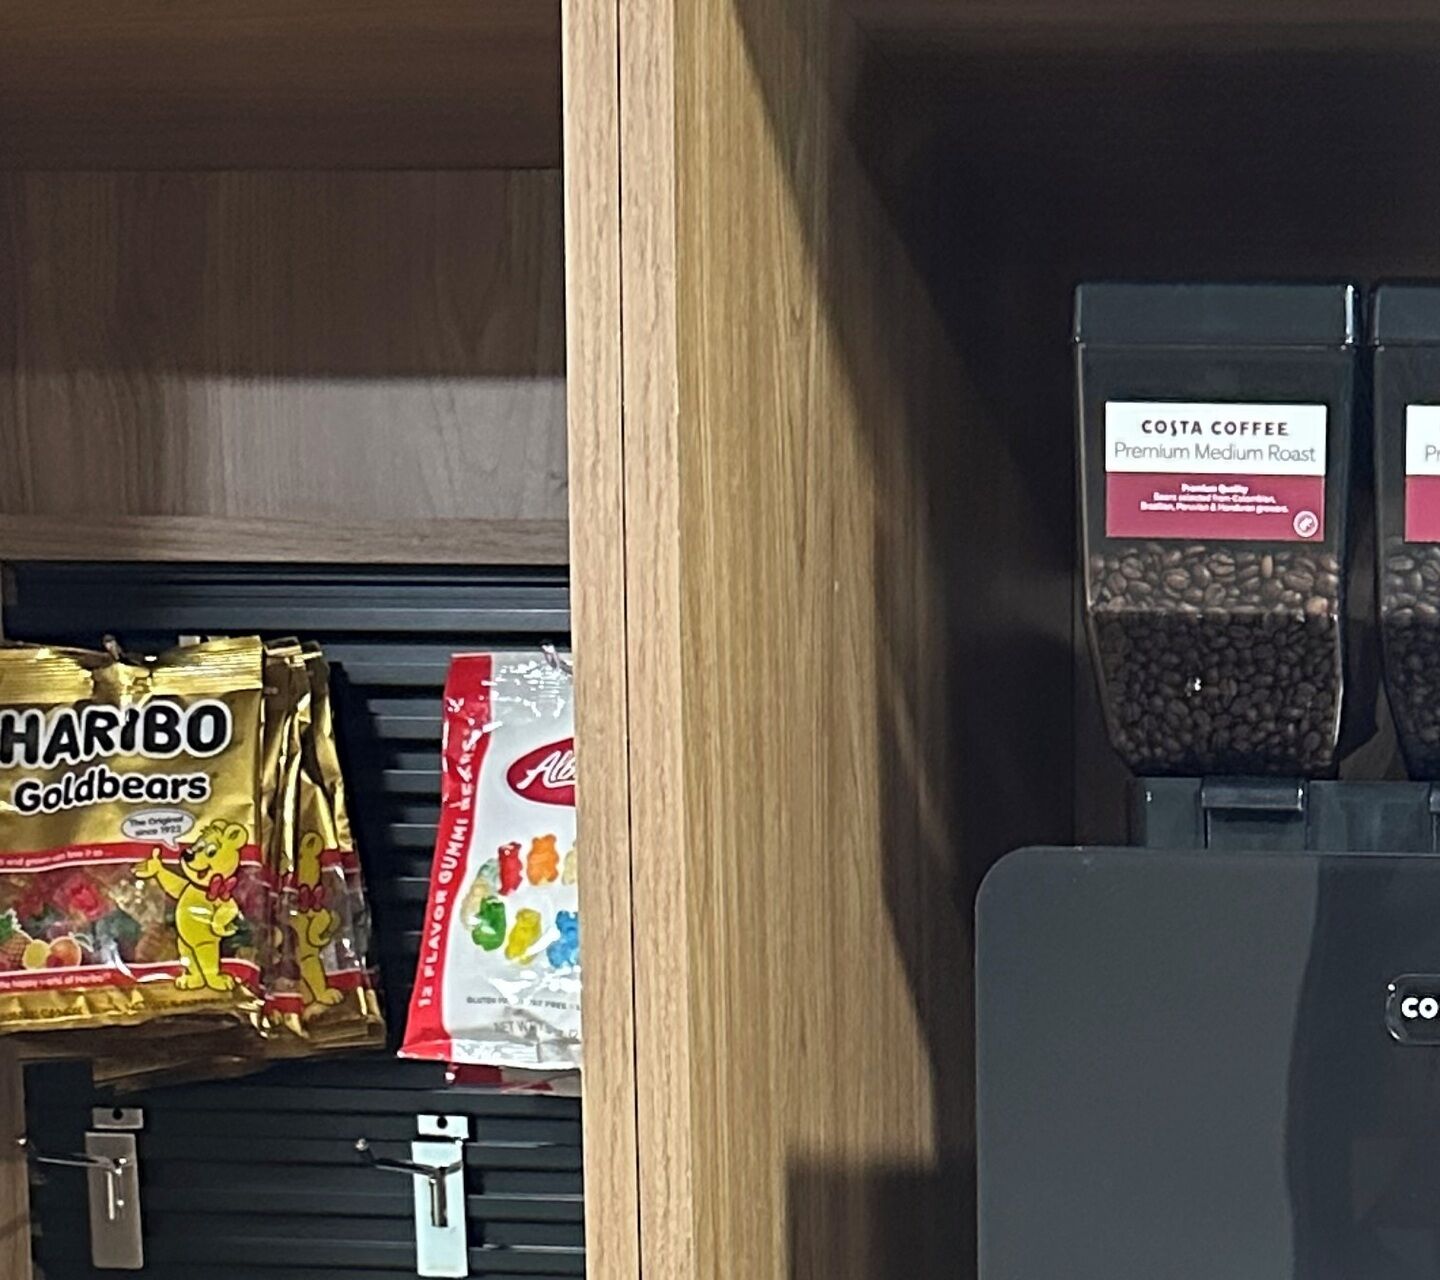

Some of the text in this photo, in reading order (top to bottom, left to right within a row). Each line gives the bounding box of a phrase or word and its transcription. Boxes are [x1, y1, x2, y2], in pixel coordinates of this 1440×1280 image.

[1142, 419, 1289, 436] COSTA COFFEE
[1114, 442, 1316, 462] Premium Medium Roast
[0, 702, 229, 766] HARIBO
[14, 768, 208, 812] Goldbears
[424, 888, 448, 979] FLAVOR
[438, 818, 469, 884] GUMMI
